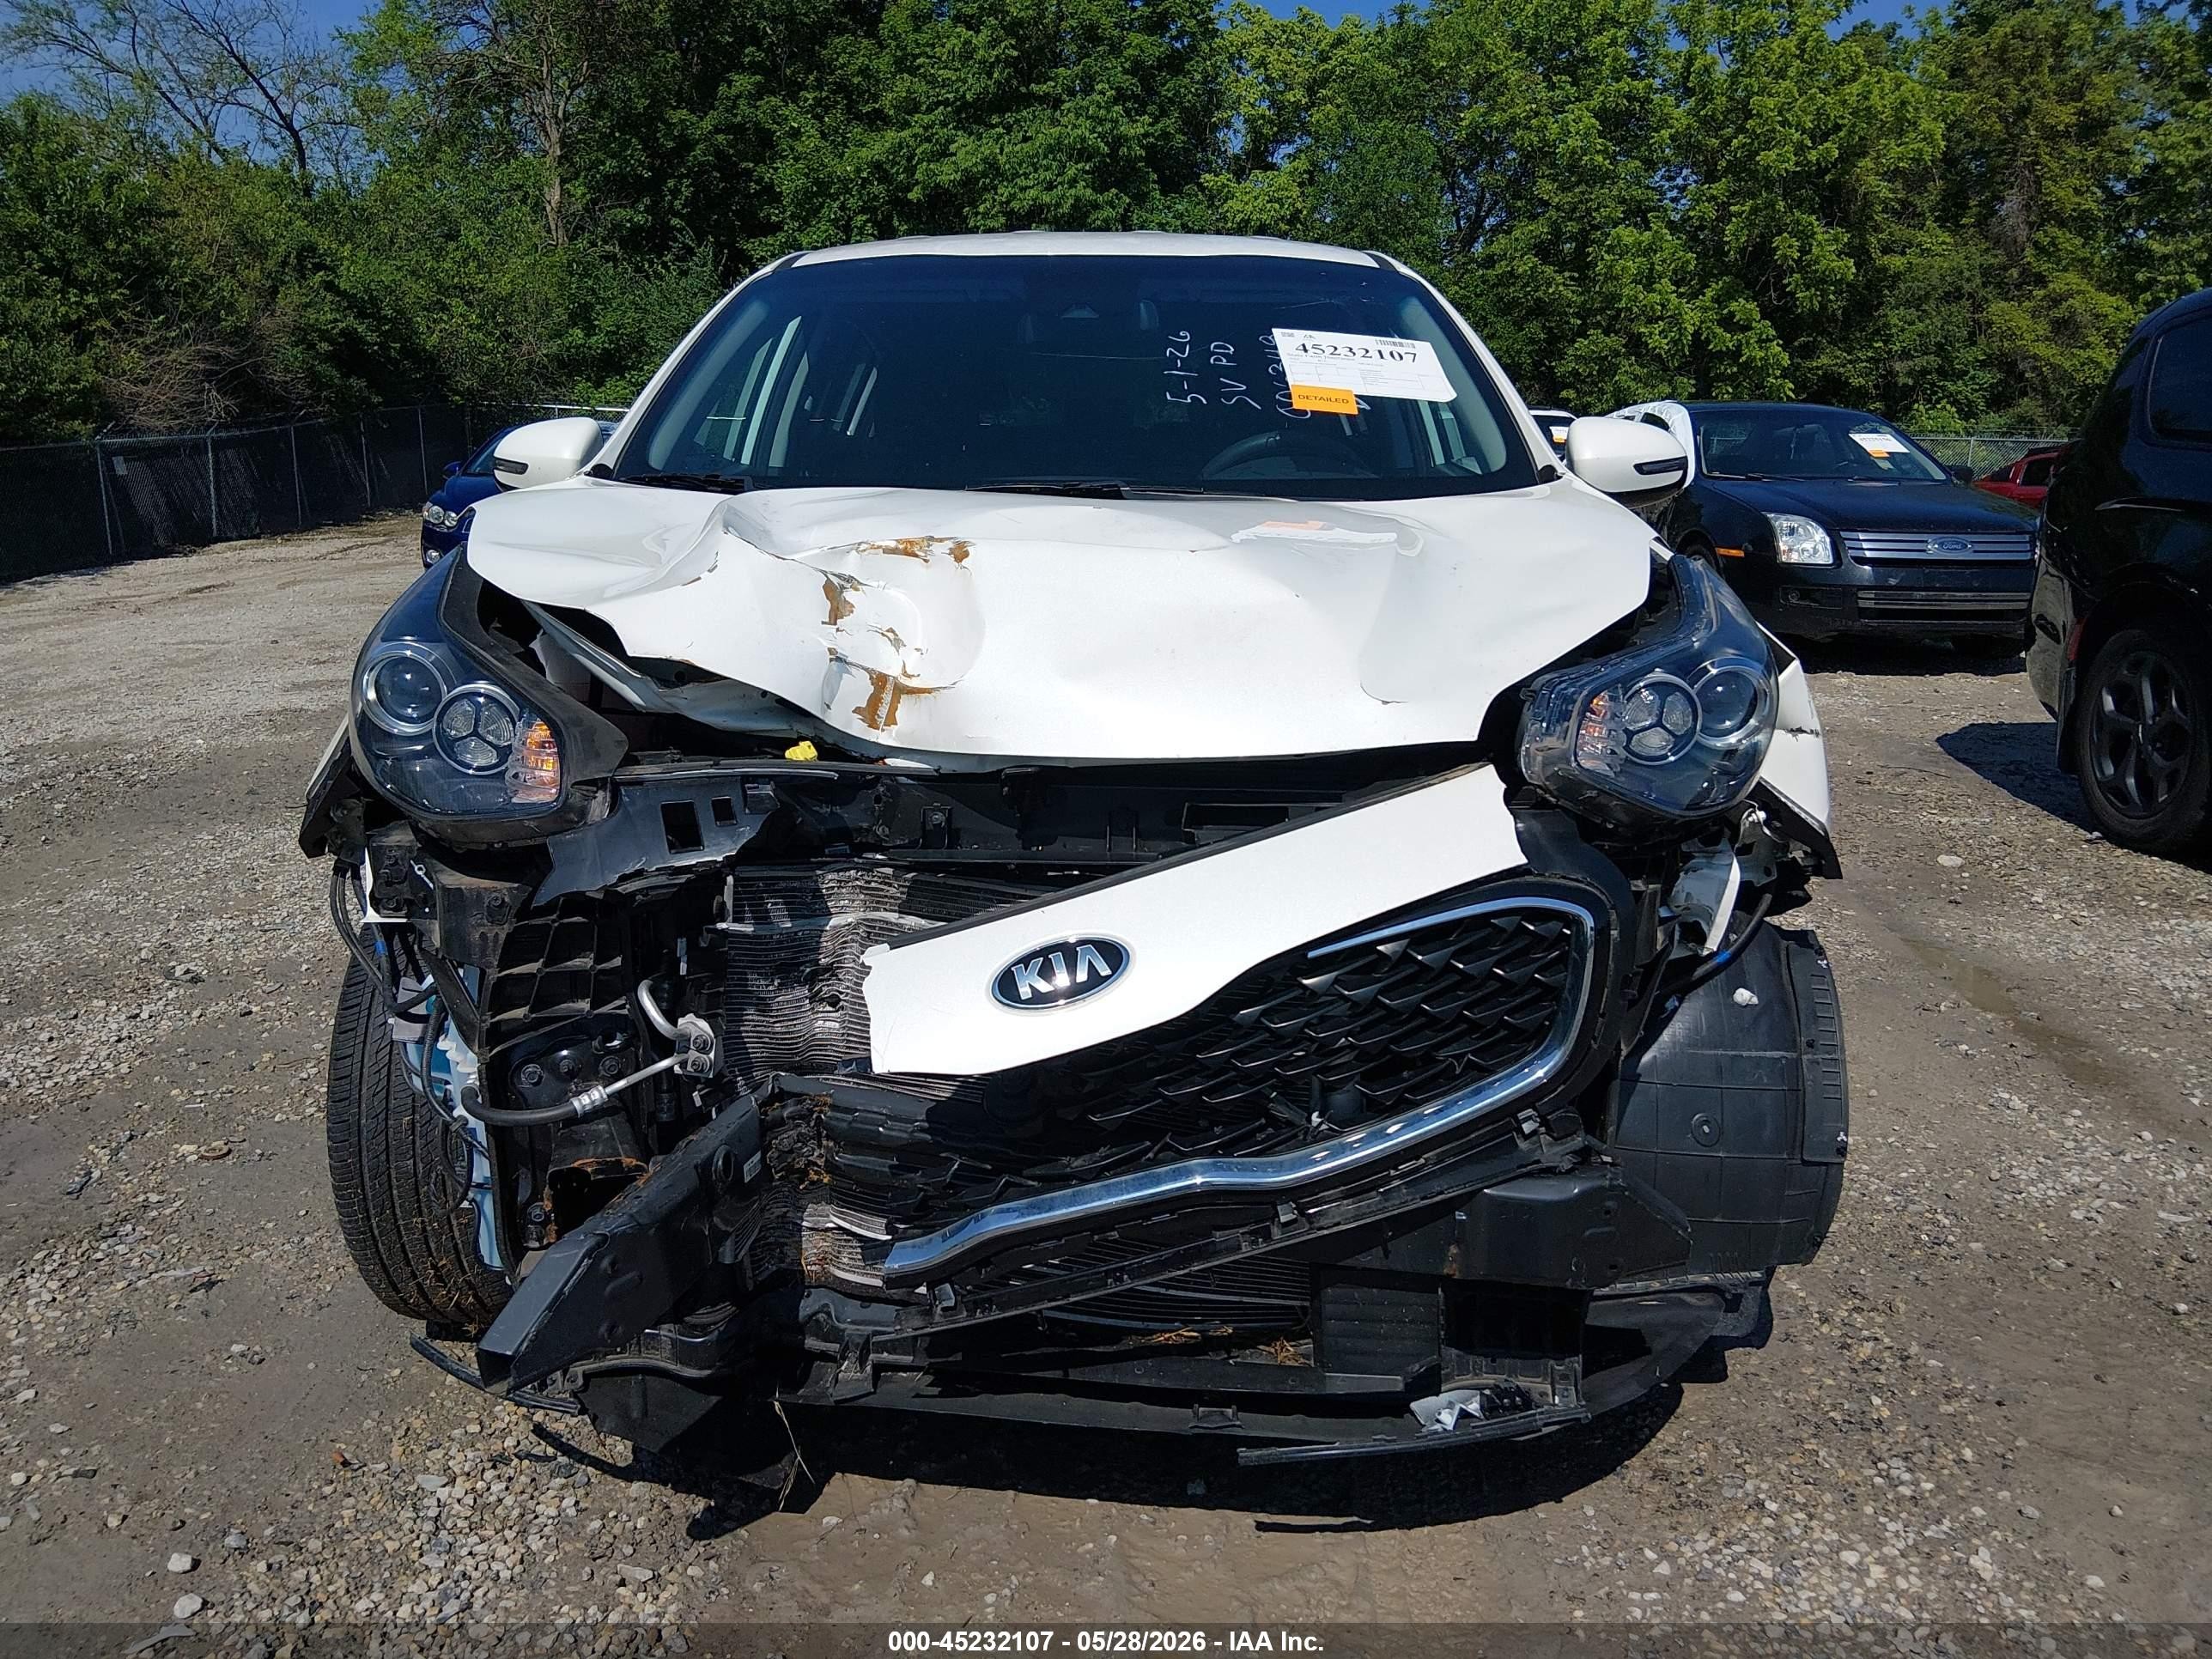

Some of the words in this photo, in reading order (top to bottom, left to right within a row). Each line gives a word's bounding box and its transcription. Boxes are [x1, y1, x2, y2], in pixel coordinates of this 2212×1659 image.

[1210, 342, 1237, 365] PD
[1294, 343, 1417, 363] 45232107
[1297, 394, 1349, 404] DETAILED
[1012, 944, 1112, 1000] KIA
